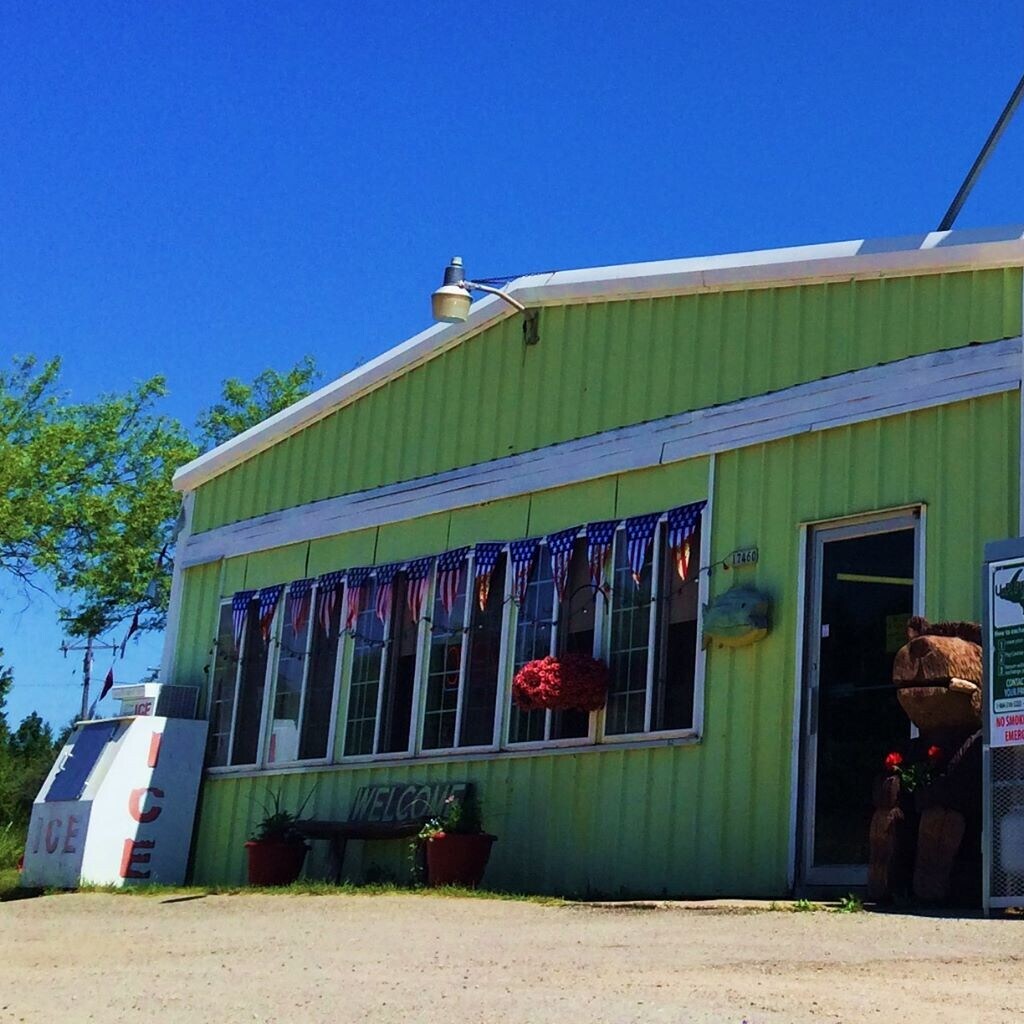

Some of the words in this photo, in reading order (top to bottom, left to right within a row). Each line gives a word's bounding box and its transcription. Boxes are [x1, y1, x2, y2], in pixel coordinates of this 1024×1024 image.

[135, 702, 152, 716] ICE
[996, 716, 1005, 727] NO
[119, 731, 165, 879] ICE
[32, 814, 79, 854] ICE
